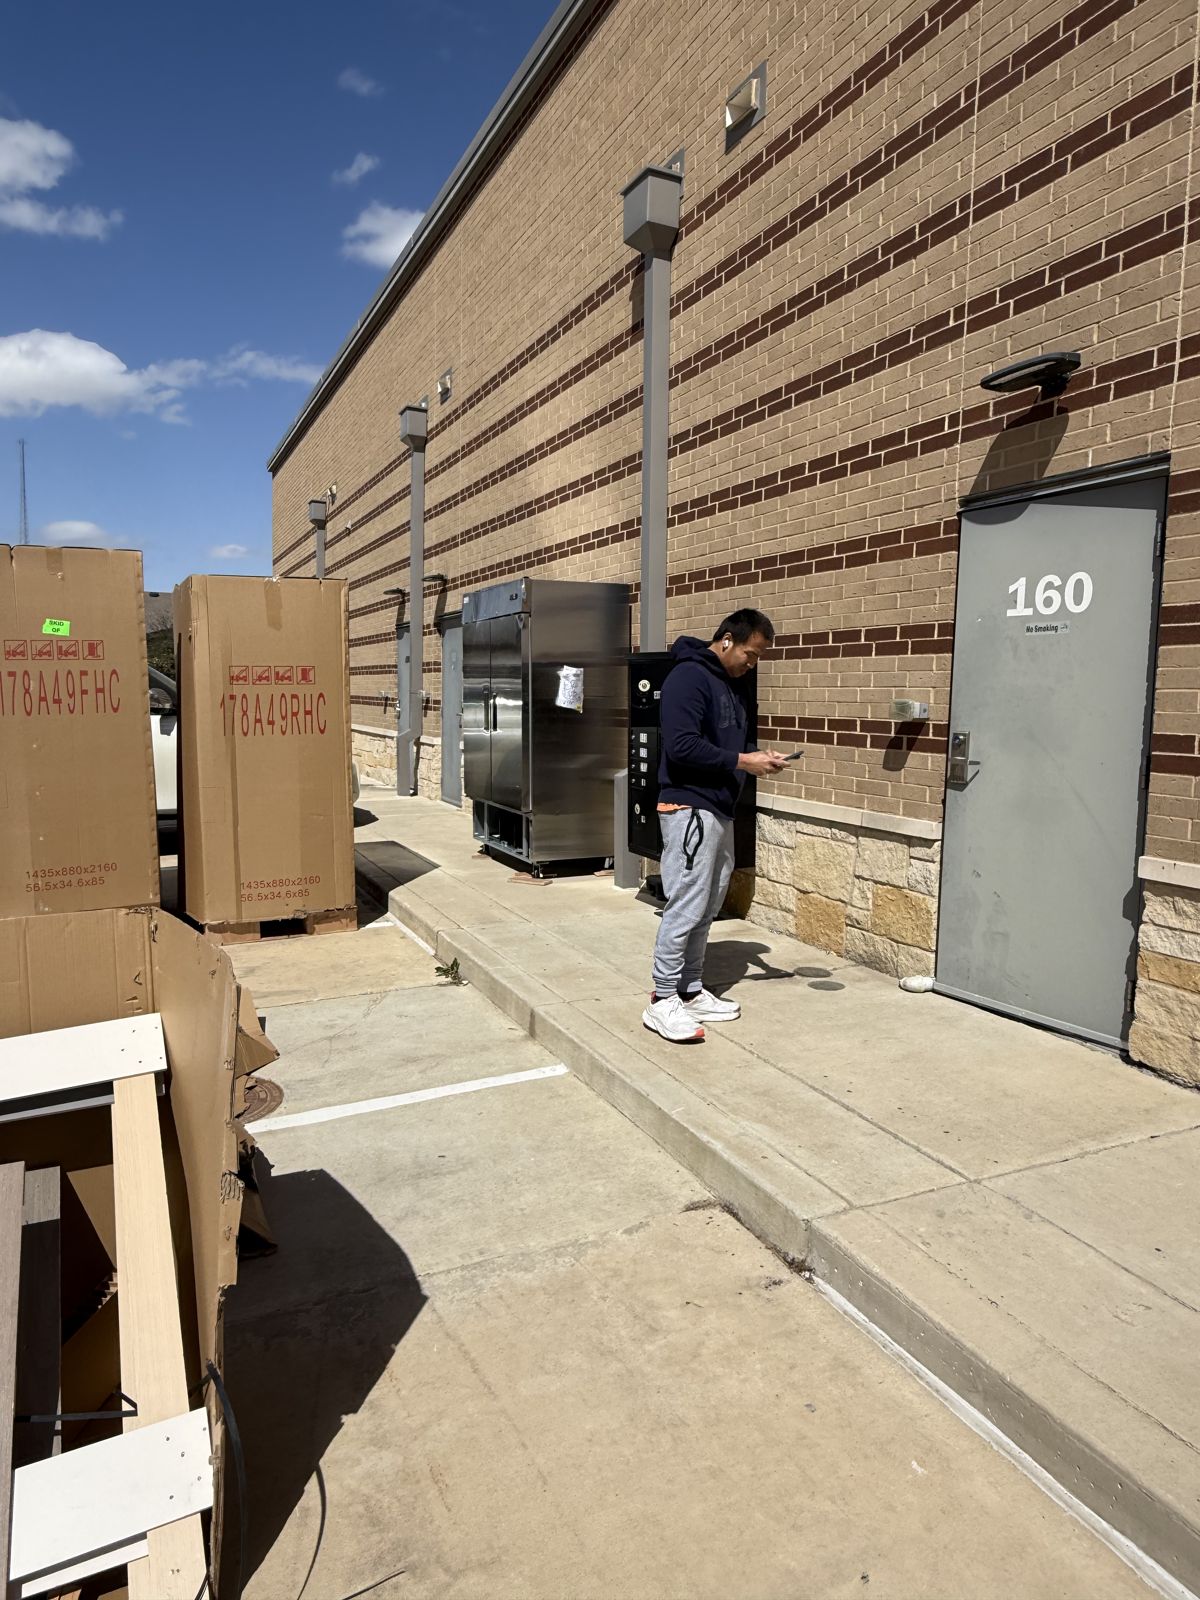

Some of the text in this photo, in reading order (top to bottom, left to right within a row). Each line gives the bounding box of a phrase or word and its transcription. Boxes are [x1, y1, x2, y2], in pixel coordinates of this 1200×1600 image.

[1006, 571, 1093, 617] 160
[1026, 624, 1059, 633] No Smoking
[220, 692, 327, 737] 178A49RHC
[25, 862, 118, 879] 1435x880x2160
[25, 876, 105, 893] 56.5x34.6x85
[240, 875, 321, 890] 1435x880x2160
